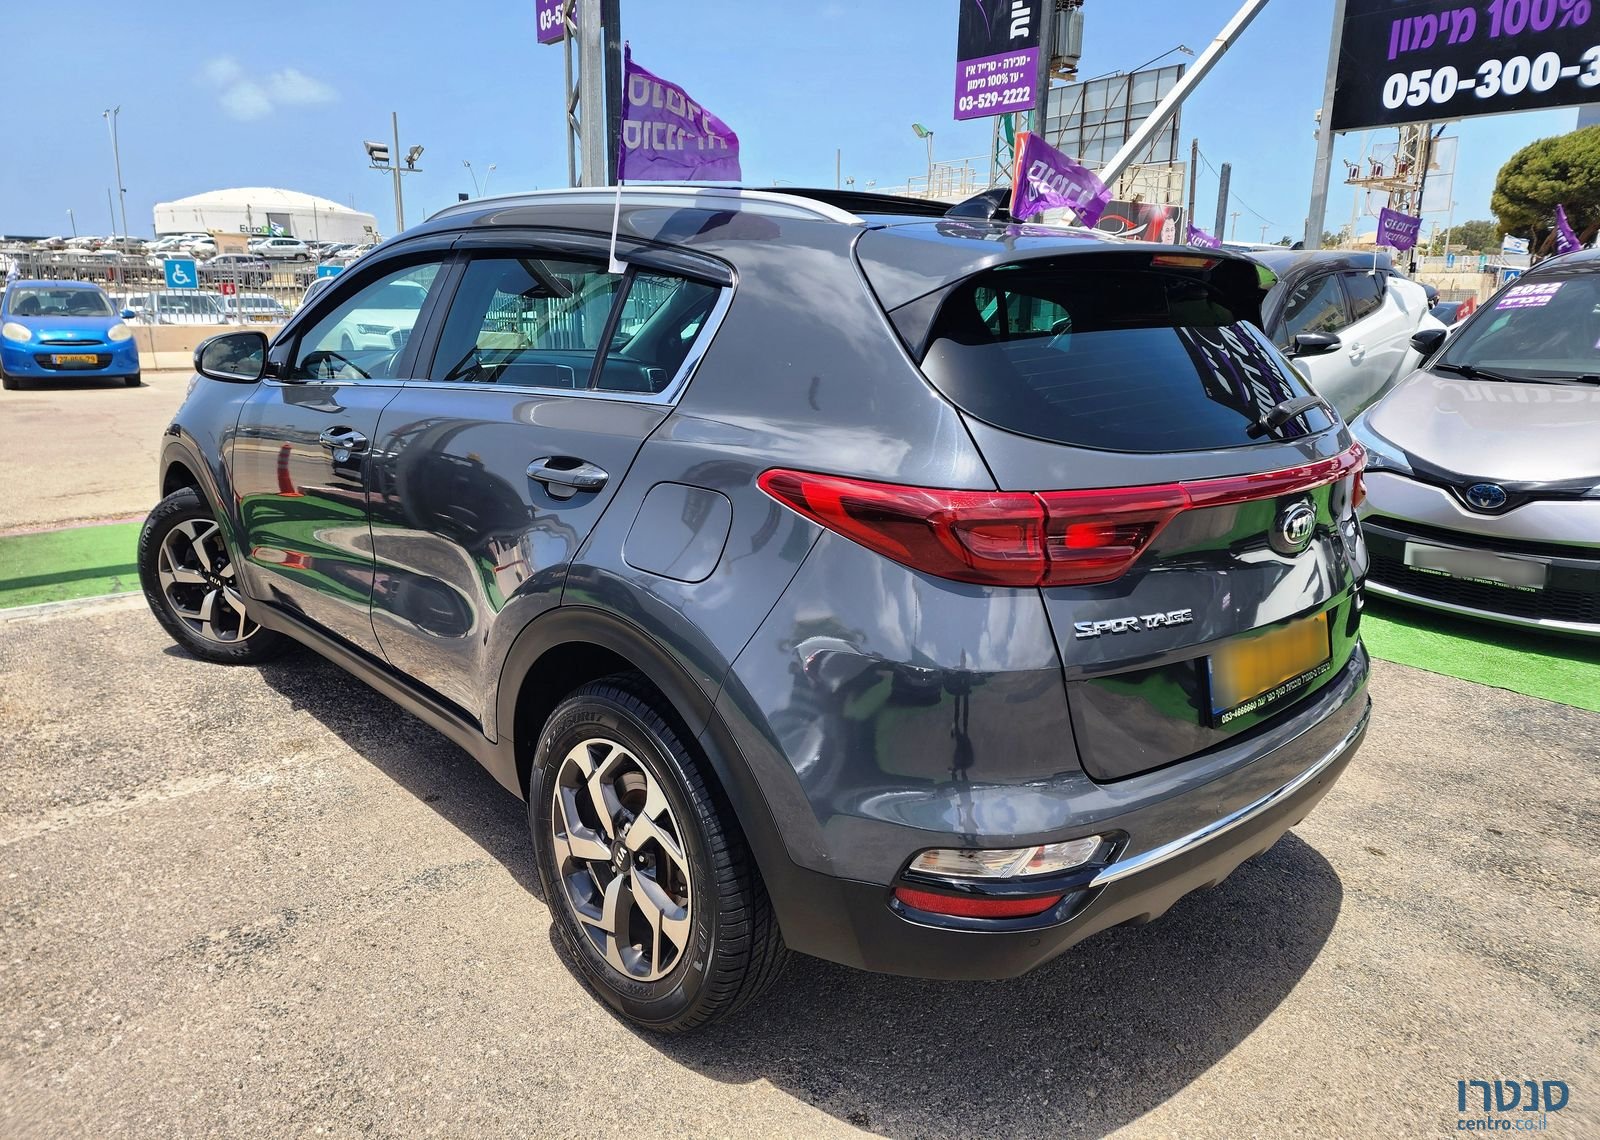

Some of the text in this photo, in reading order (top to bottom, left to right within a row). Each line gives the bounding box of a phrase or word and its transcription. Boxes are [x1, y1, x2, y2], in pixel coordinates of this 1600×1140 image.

[1387, 0, 1592, 61] 100% מימון
[965, 55, 1026, 78] מכירה טרייד אין
[1382, 45, 1600, 109] 050-300-3
[967, 72, 1019, 92] עד 100% מימון
[959, 86, 1031, 111] 03-529-2222
[615, 847, 628, 868] KIA
